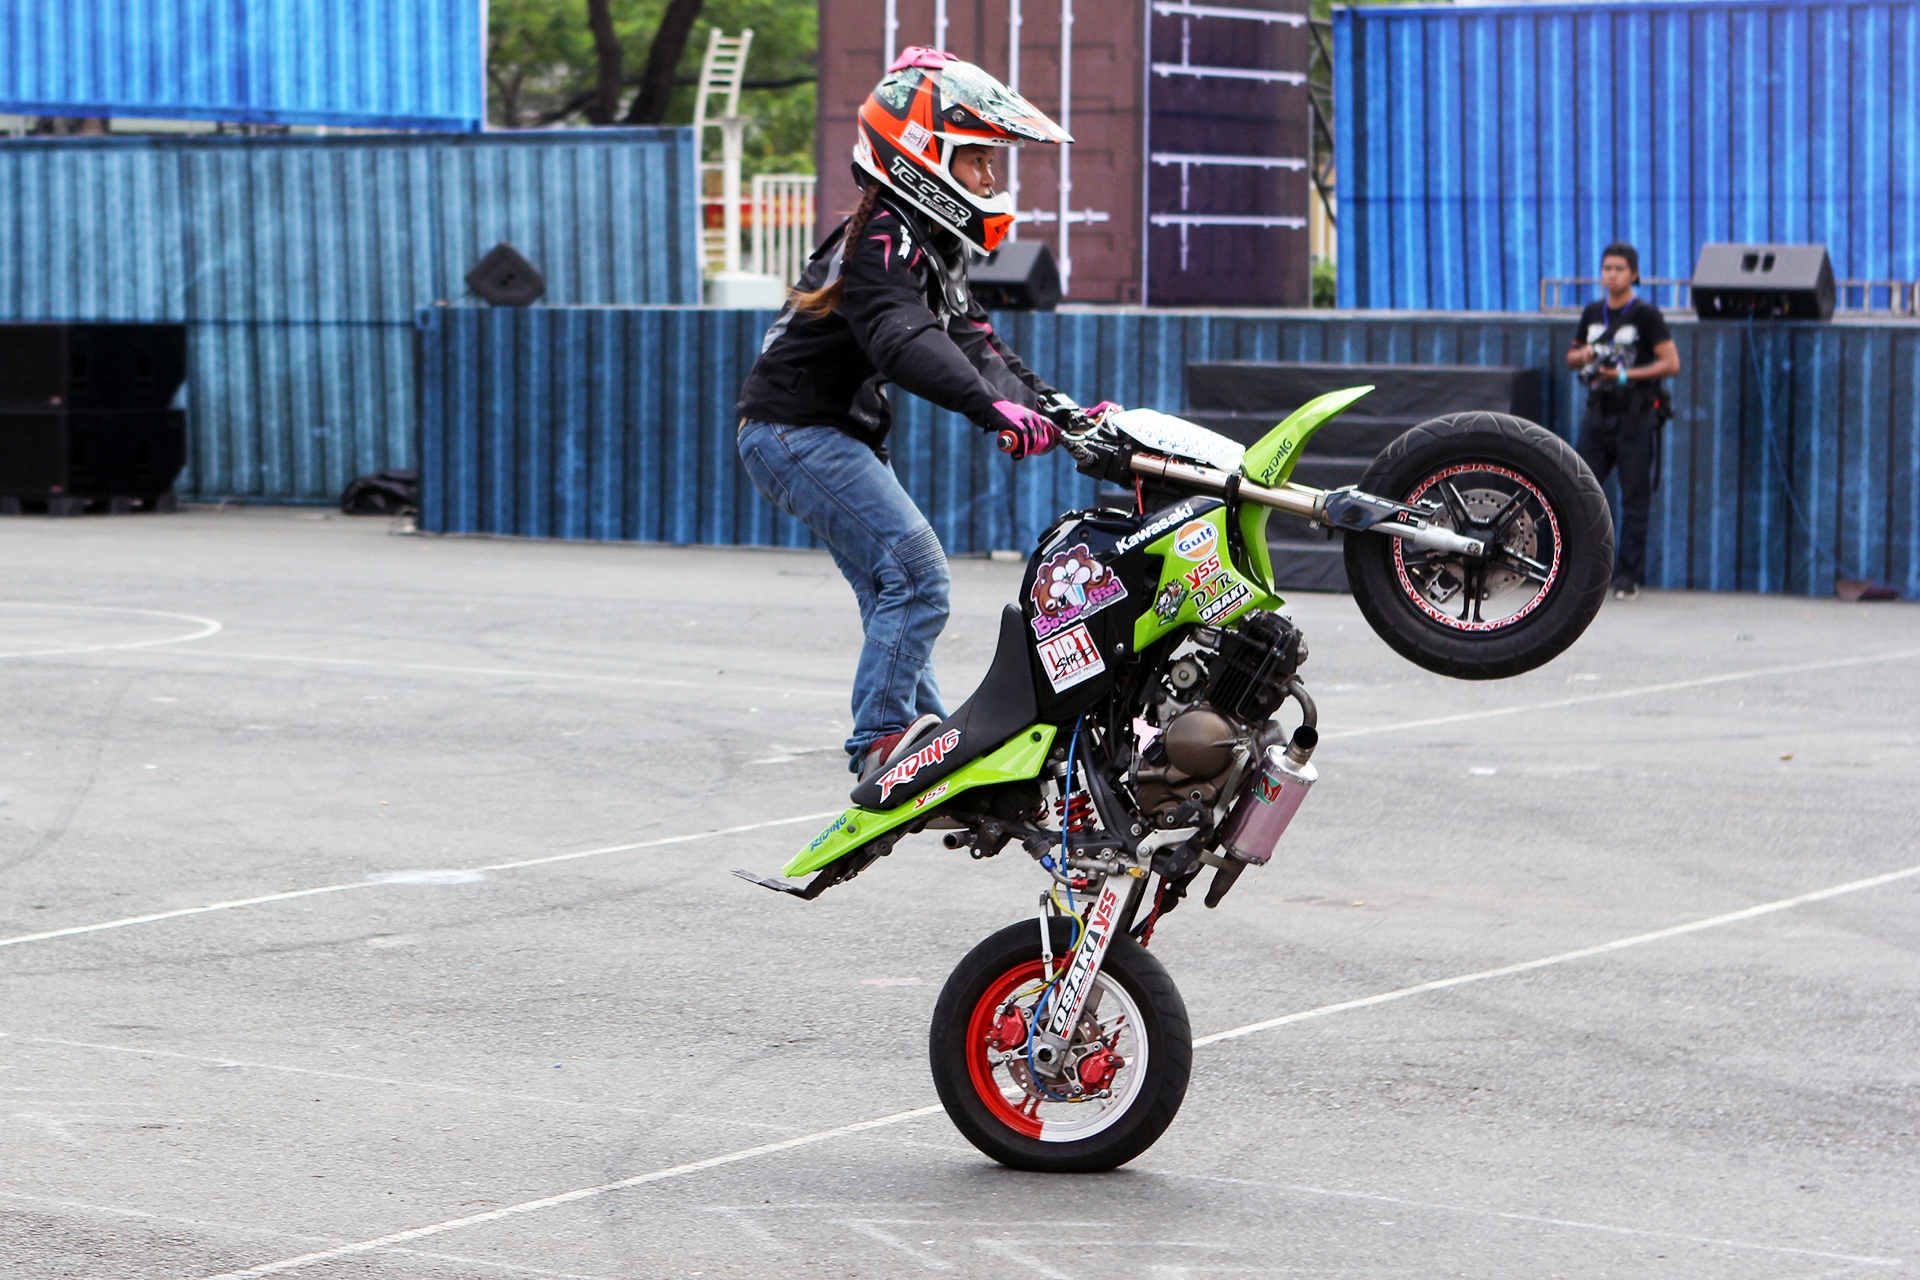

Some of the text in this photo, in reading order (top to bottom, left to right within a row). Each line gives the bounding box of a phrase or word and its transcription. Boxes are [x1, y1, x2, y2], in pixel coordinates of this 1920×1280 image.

[1261, 438, 1292, 485] RIDING
[1115, 502, 1194, 555] Kawasaki
[1178, 527, 1213, 552] Gulf
[1189, 571, 1235, 608] DVR
[1202, 583, 1246, 620] OSAKI
[1040, 626, 1097, 679] DIRT
[875, 729, 961, 803] RIDING
[809, 813, 847, 852] RIDING
[1092, 887, 1117, 932] YSS
[1053, 933, 1097, 1033] OSAKI
